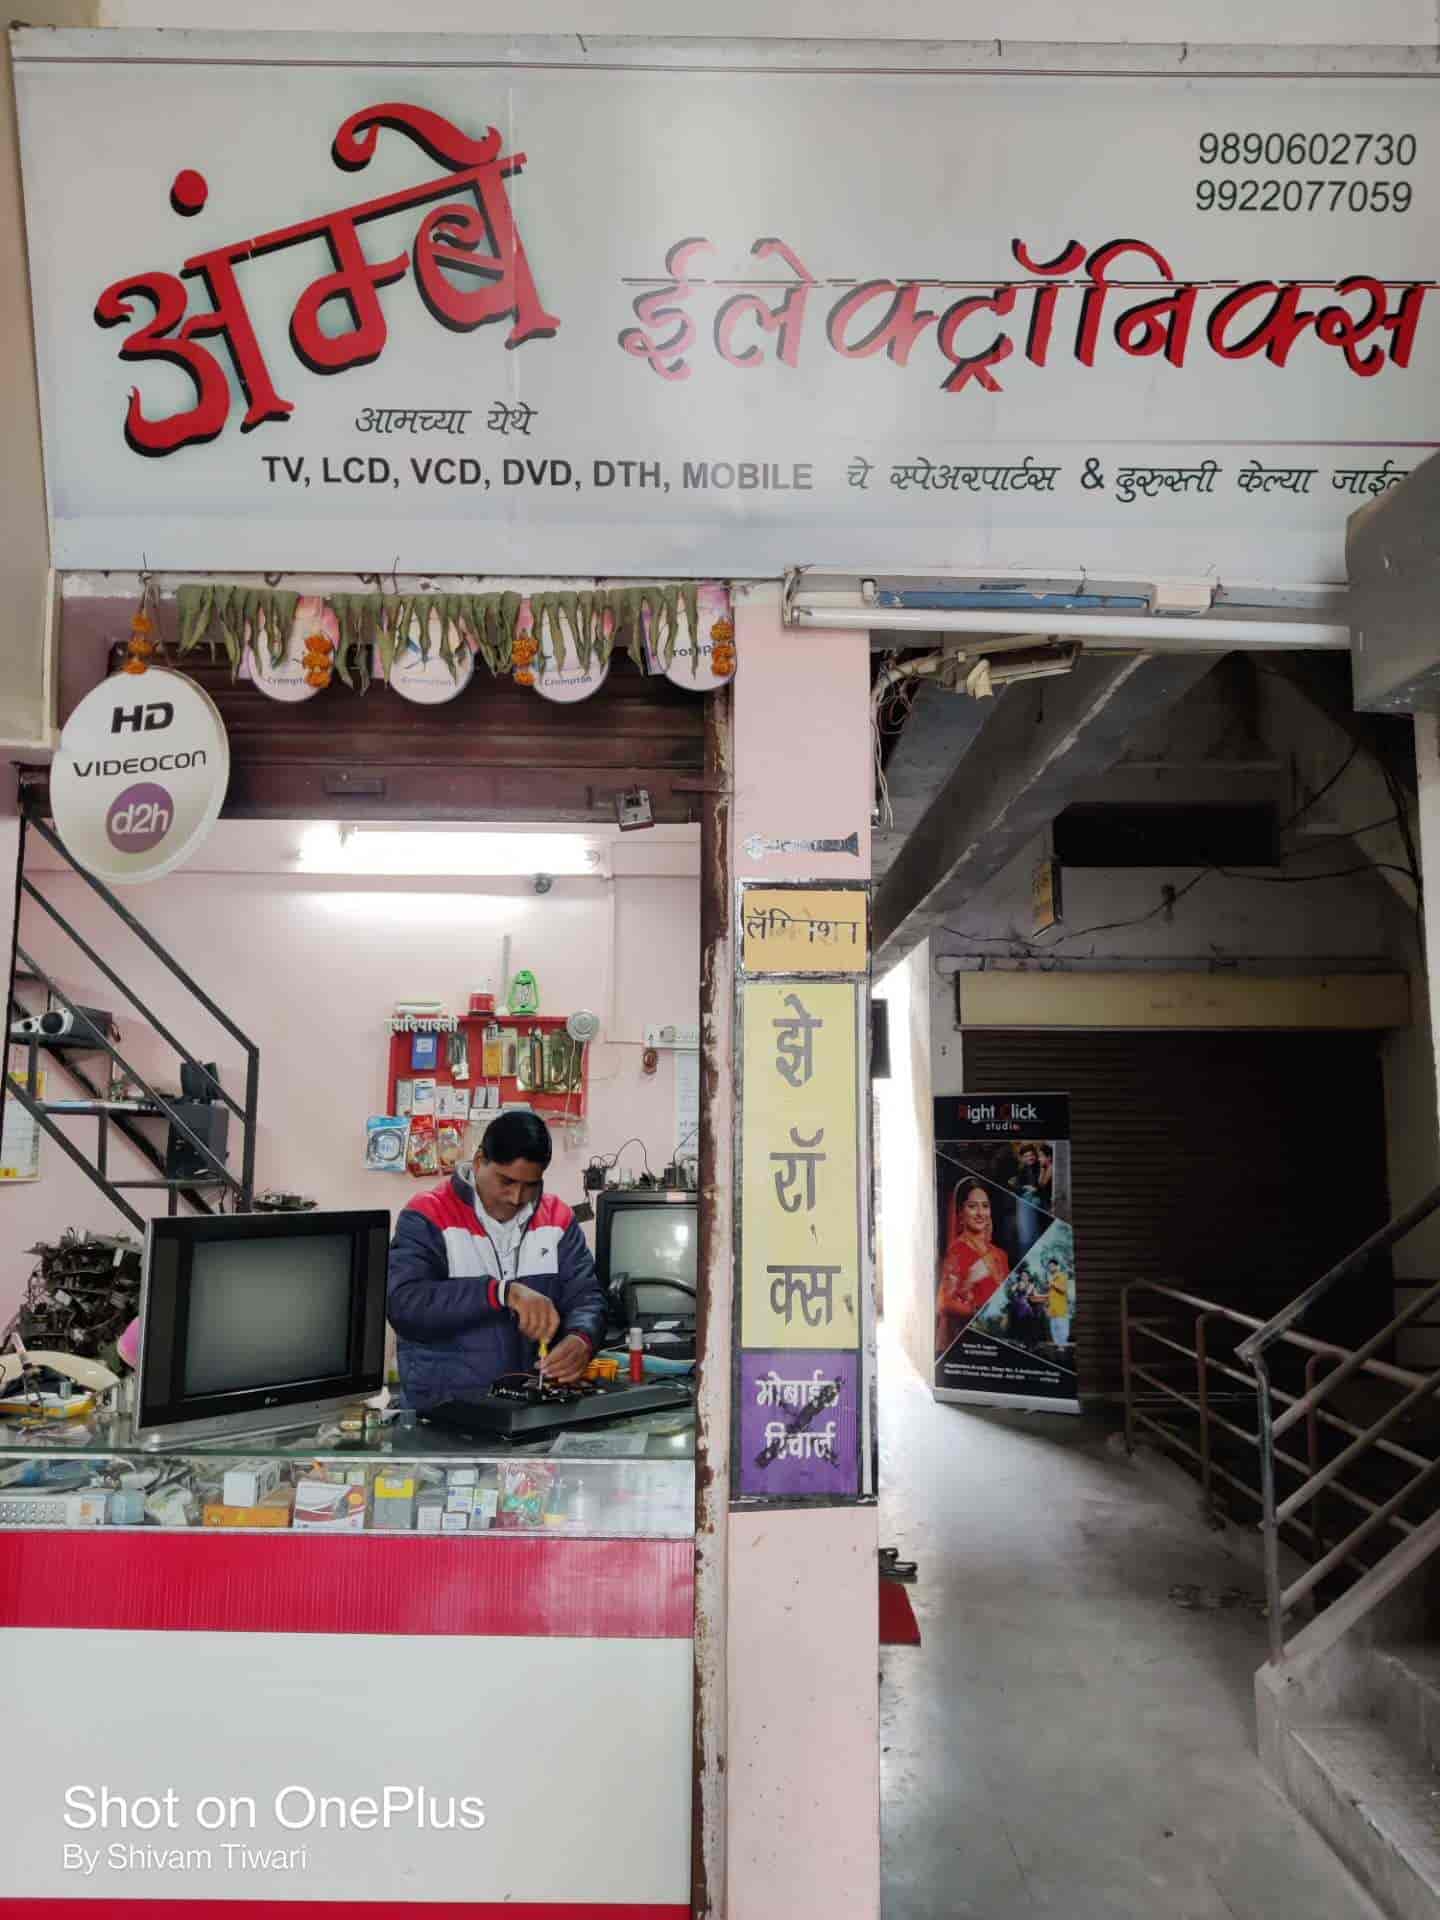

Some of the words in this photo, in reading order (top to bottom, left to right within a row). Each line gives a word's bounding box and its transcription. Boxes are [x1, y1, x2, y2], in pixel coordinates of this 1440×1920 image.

[1199, 132, 1417, 166] 9890602730
[1196, 179, 1412, 213] 9922077059
[355, 407, 472, 434] आमच्या
[487, 401, 538, 435] येथे
[262, 456, 311, 487] TV,
[322, 456, 400, 488] LCD,
[410, 458, 490, 489] VCD,
[503, 459, 581, 492] DVD,
[593, 460, 670, 493] DTH,
[682, 462, 813, 490] MOBILE
[848, 456, 874, 489] चे
[1080, 457, 1104, 490] &
[1237, 460, 1318, 493] केल्या
[111, 702, 173, 733] HD
[111, 803, 169, 834] d2h
